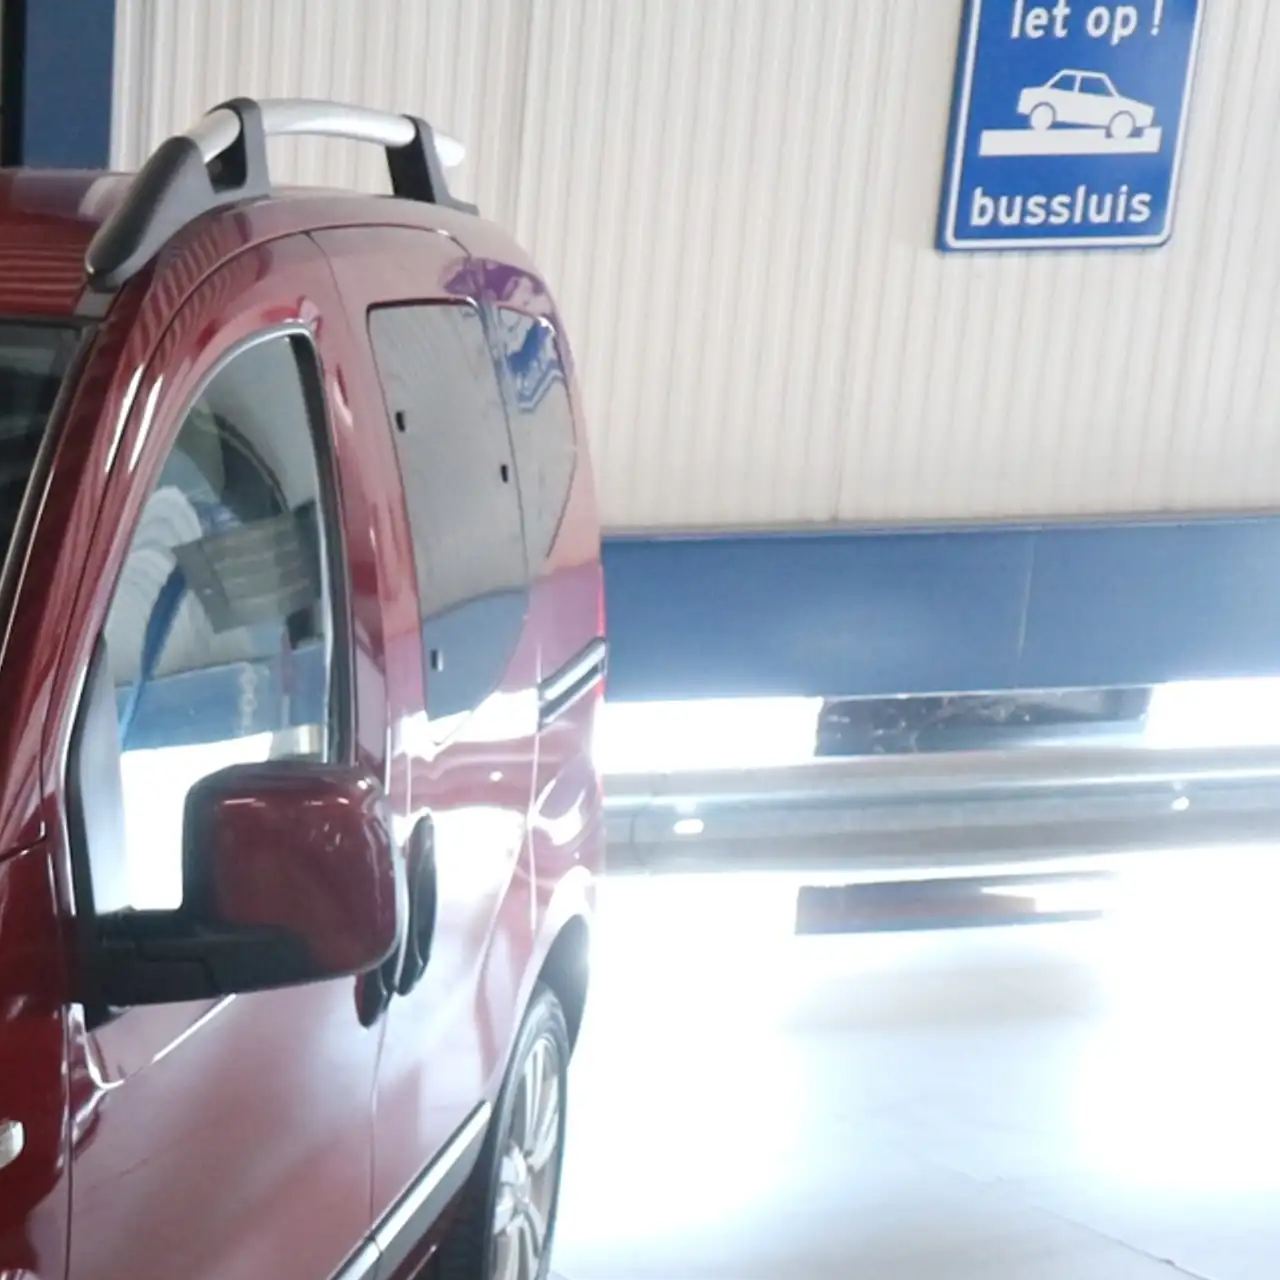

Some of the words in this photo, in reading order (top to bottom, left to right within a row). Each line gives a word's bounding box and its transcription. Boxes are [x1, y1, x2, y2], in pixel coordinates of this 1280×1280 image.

[1010, 0, 1071, 38] let
[1085, 5, 1138, 46] op
[969, 184, 1153, 227] bussluis
